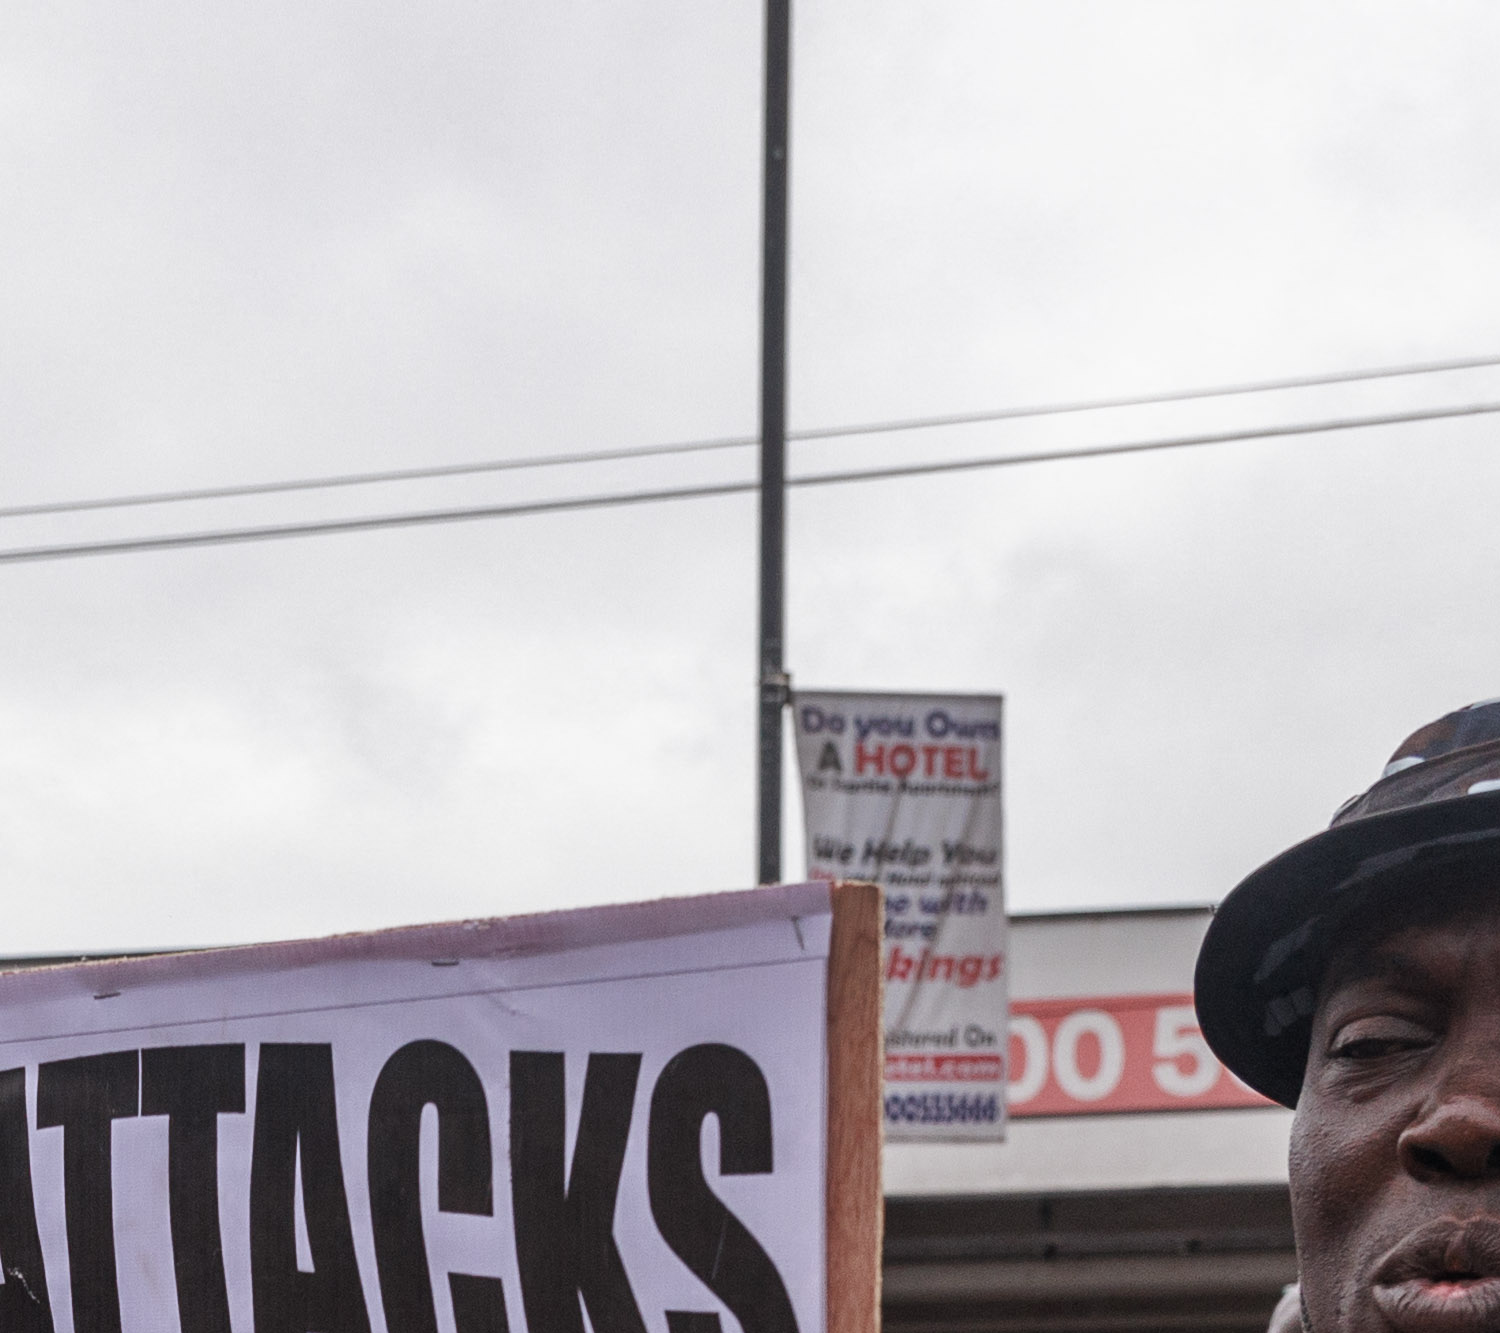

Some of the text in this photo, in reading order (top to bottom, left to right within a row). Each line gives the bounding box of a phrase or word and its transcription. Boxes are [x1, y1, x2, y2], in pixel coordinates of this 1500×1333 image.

[855, 717, 913, 743] you
[818, 741, 988, 780] A HOTEL
[1152, 1005, 1245, 1098] 5
